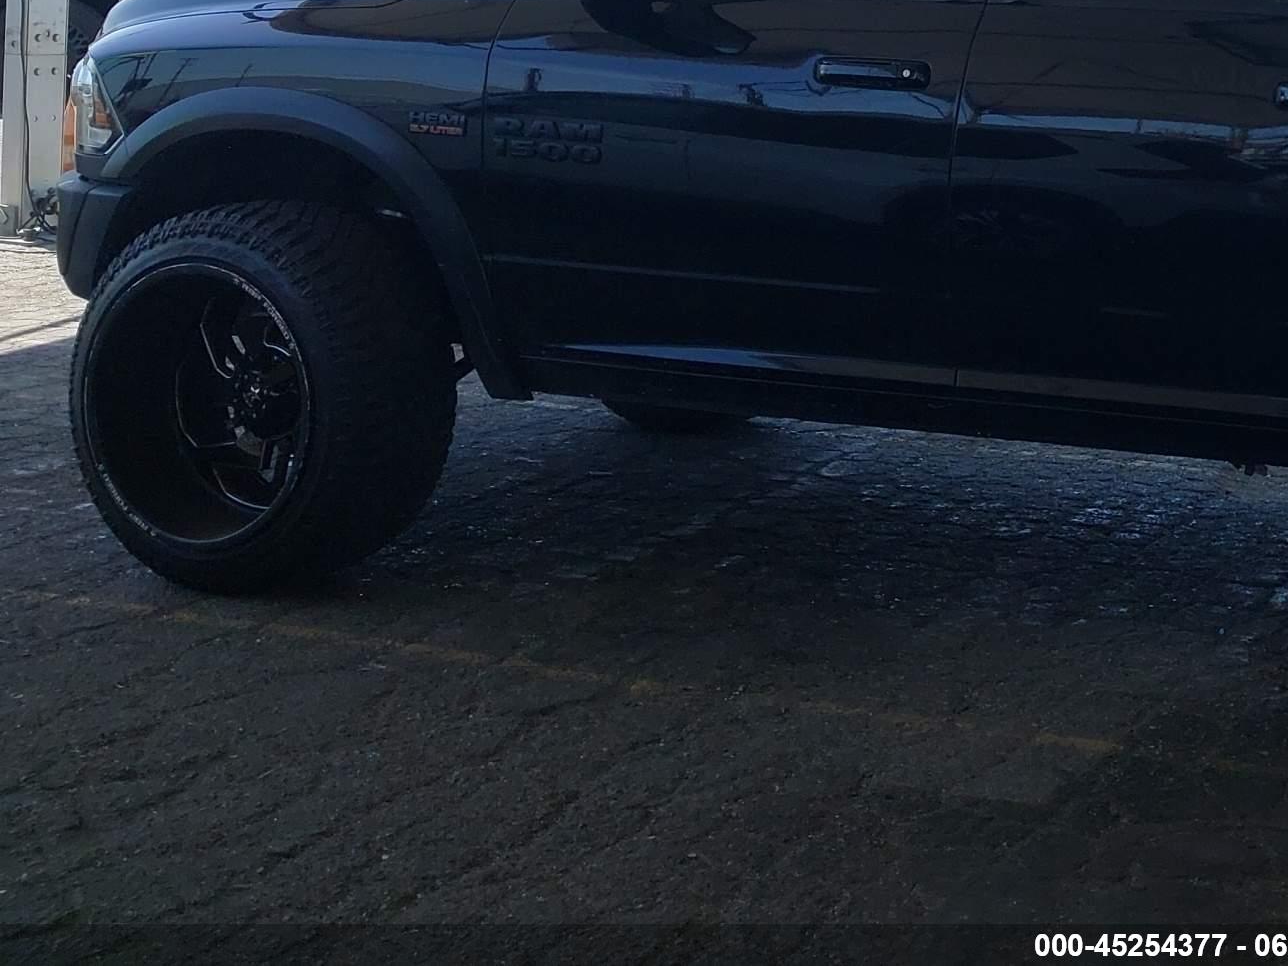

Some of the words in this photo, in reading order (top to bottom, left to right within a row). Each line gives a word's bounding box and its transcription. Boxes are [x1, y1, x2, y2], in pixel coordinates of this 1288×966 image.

[409, 111, 465, 125] HEMI
[493, 117, 604, 144] RAM
[492, 137, 603, 164] 1500
